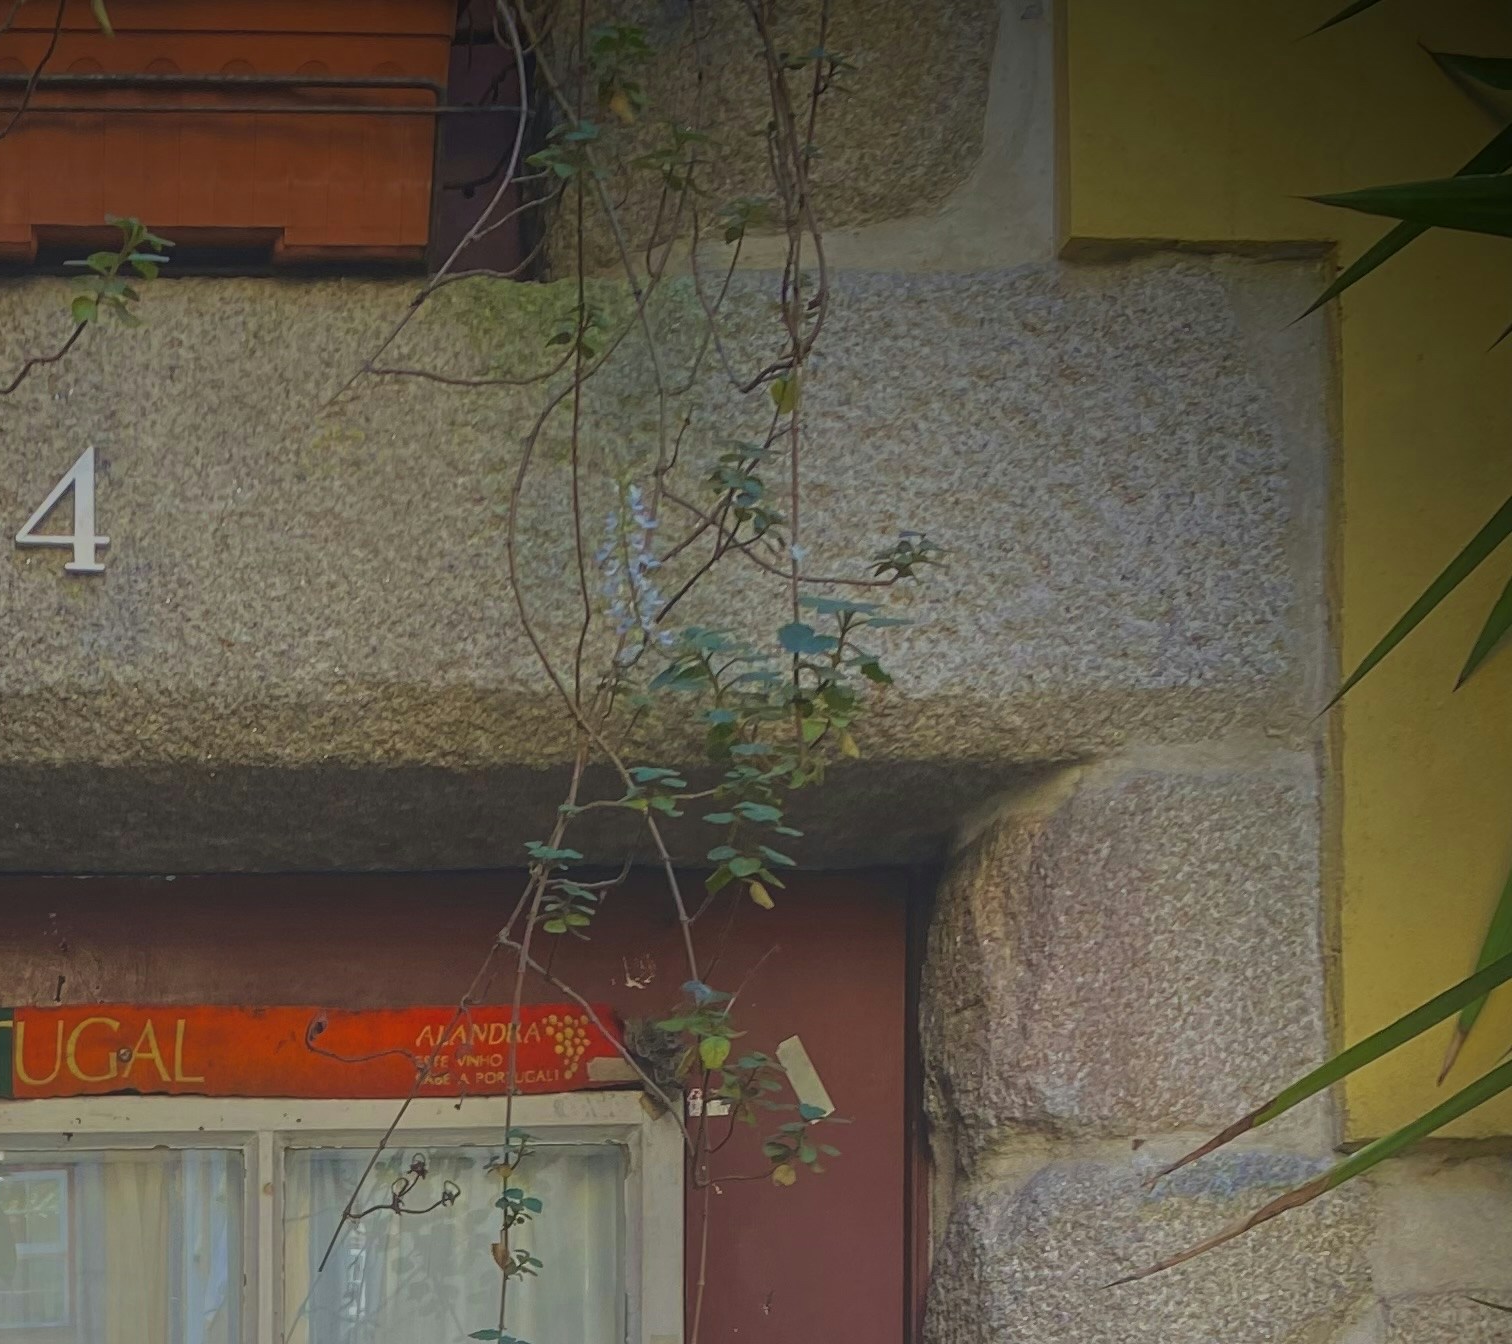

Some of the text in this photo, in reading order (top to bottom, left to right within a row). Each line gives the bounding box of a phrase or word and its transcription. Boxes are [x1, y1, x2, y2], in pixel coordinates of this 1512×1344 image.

[15, 446, 110, 571] 4
[458, 1053, 503, 1067] VINHO
[458, 1073, 470, 1085] A
[476, 1070, 559, 1085] PORUGAL!
